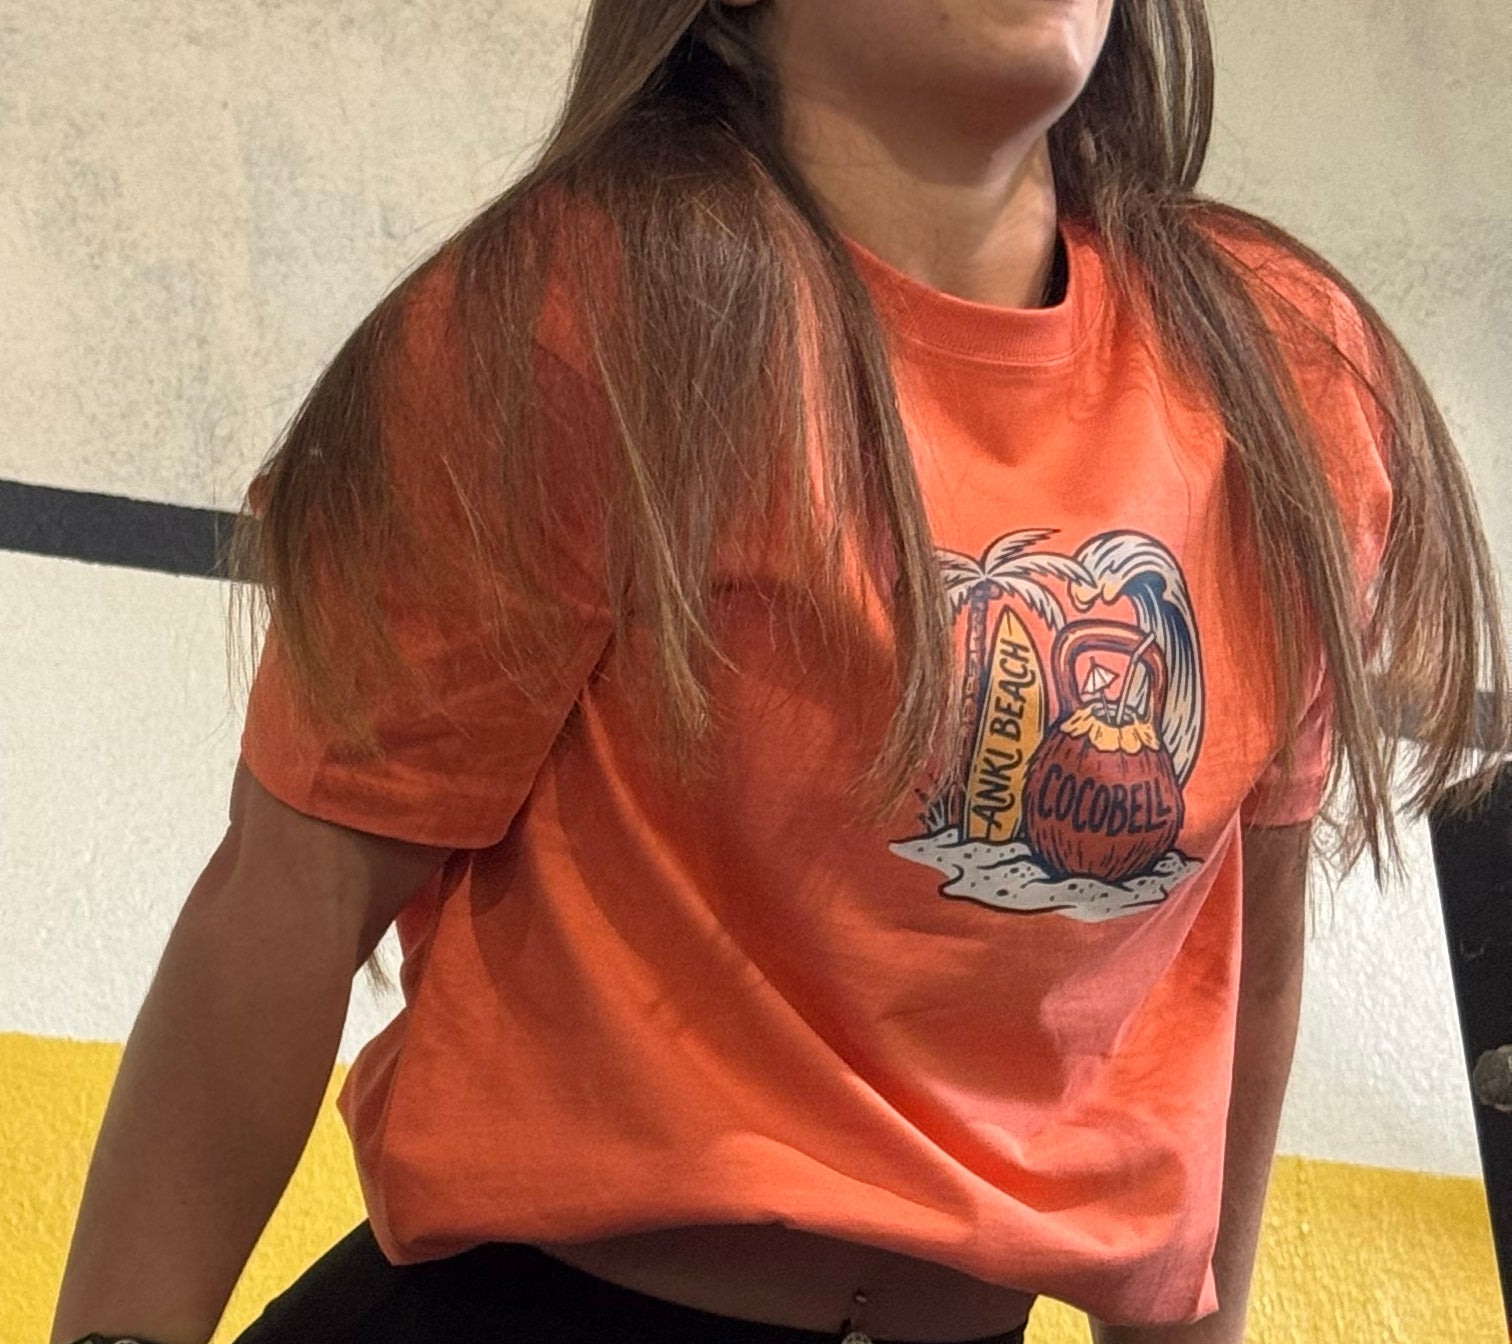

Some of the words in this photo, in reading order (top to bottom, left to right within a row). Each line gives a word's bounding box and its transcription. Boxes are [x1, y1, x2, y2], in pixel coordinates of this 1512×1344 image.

[989, 637, 1036, 741] BEACH
[971, 747, 1023, 830] ANKI
[1038, 764, 1169, 835] COCOBELL
